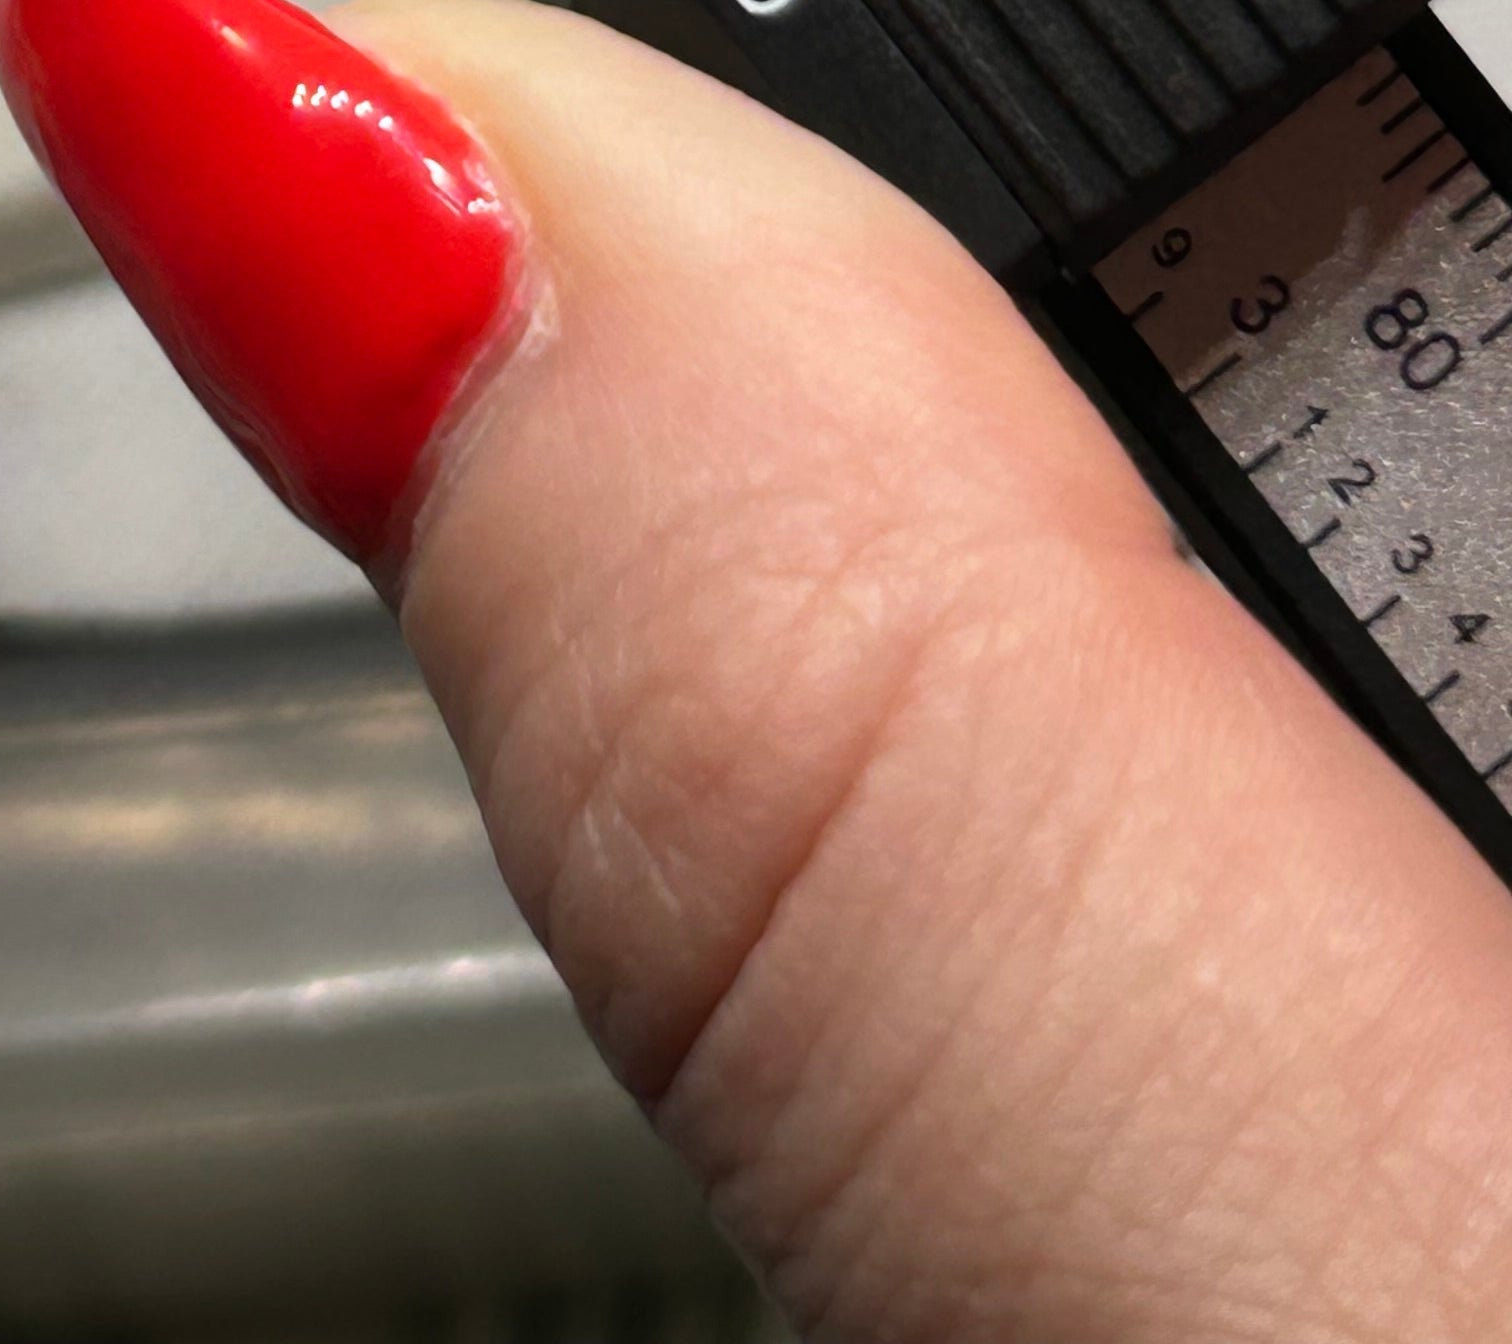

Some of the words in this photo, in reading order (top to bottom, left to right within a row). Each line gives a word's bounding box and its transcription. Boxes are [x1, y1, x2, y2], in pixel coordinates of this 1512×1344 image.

[1151, 227, 1191, 270] 9
[1228, 275, 1289, 336] 3
[1293, 405, 1329, 440] 1
[1329, 459, 1377, 506] 2
[1391, 533, 1434, 575] 3
[1449, 613, 1490, 644] 4
[1363, 288, 1462, 391] 80
